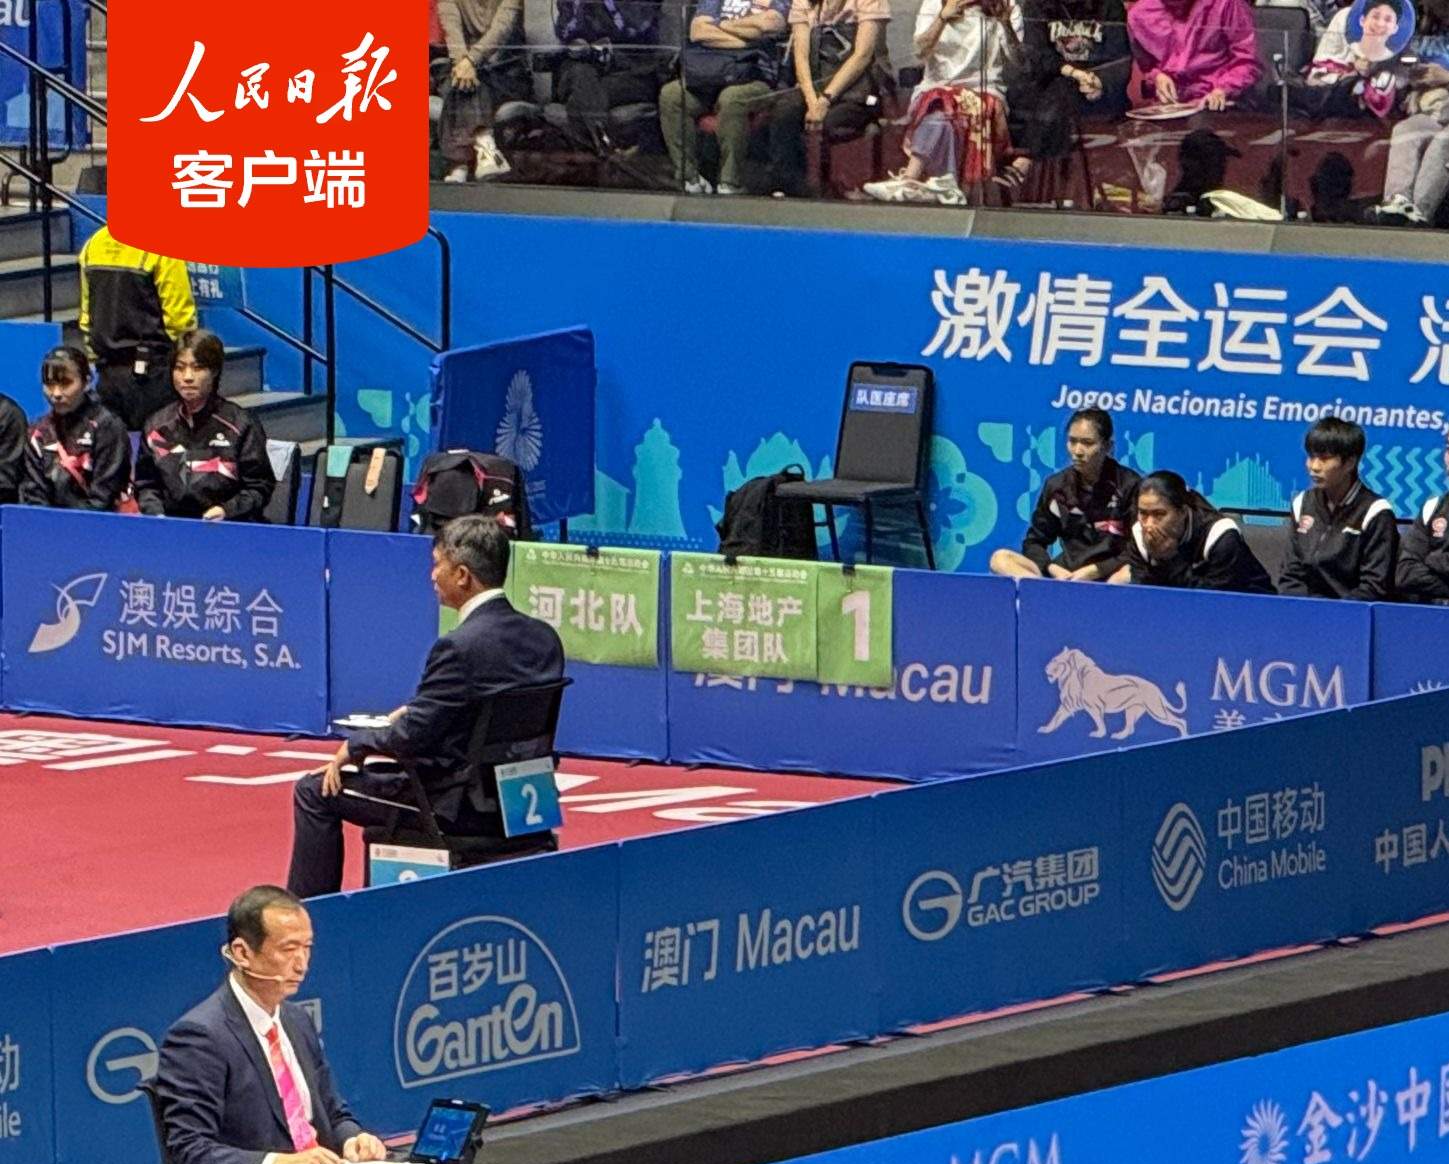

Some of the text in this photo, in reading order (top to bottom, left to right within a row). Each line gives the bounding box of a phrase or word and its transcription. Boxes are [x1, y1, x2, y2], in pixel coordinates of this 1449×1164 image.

[921, 268, 1388, 382] 激情全运会
[1051, 384, 1127, 412] Jogos
[1131, 388, 1257, 419] Nacionais
[529, 584, 644, 636] 河北队
[686, 589, 803, 626] 上海地产
[841, 590, 871, 662] 1
[103, 630, 301, 669] SJM Resorts, S.A.
[702, 625, 789, 664] 集团队
[1210, 657, 1345, 709] MGM
[521, 783, 543, 826] 2
[1217, 782, 1326, 851] 中国移动
[967, 846, 1099, 904] 广汽集团
[1218, 847, 1327, 890] China Mobile
[967, 884, 1100, 929] GAC GROUP
[428, 938, 526, 1001] 百岁山
[641, 905, 860, 993] 澳门 Macau
